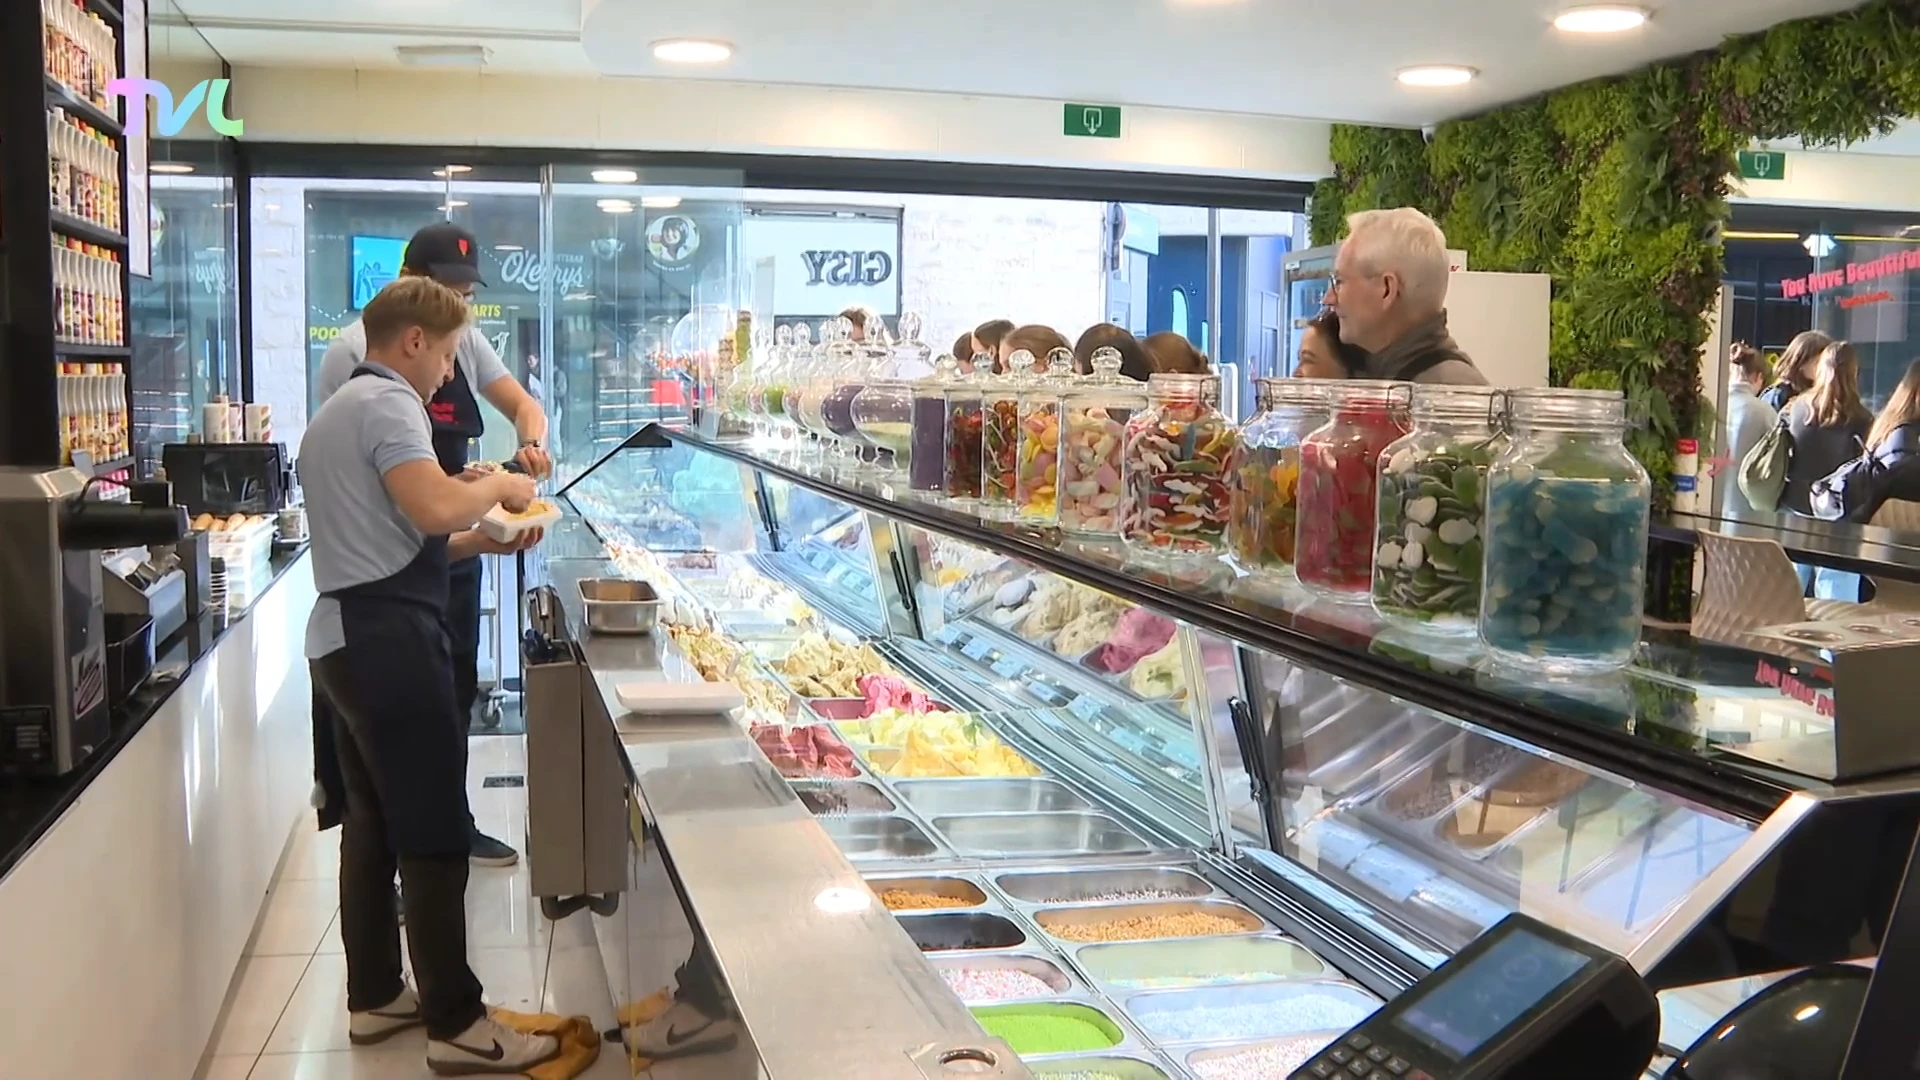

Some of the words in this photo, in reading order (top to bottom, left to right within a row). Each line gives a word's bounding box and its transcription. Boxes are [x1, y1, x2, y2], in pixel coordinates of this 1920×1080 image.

[501, 249, 584, 296] O'Lerys
[472, 303, 502, 318] ARTS
[309, 326, 341, 341] POO
